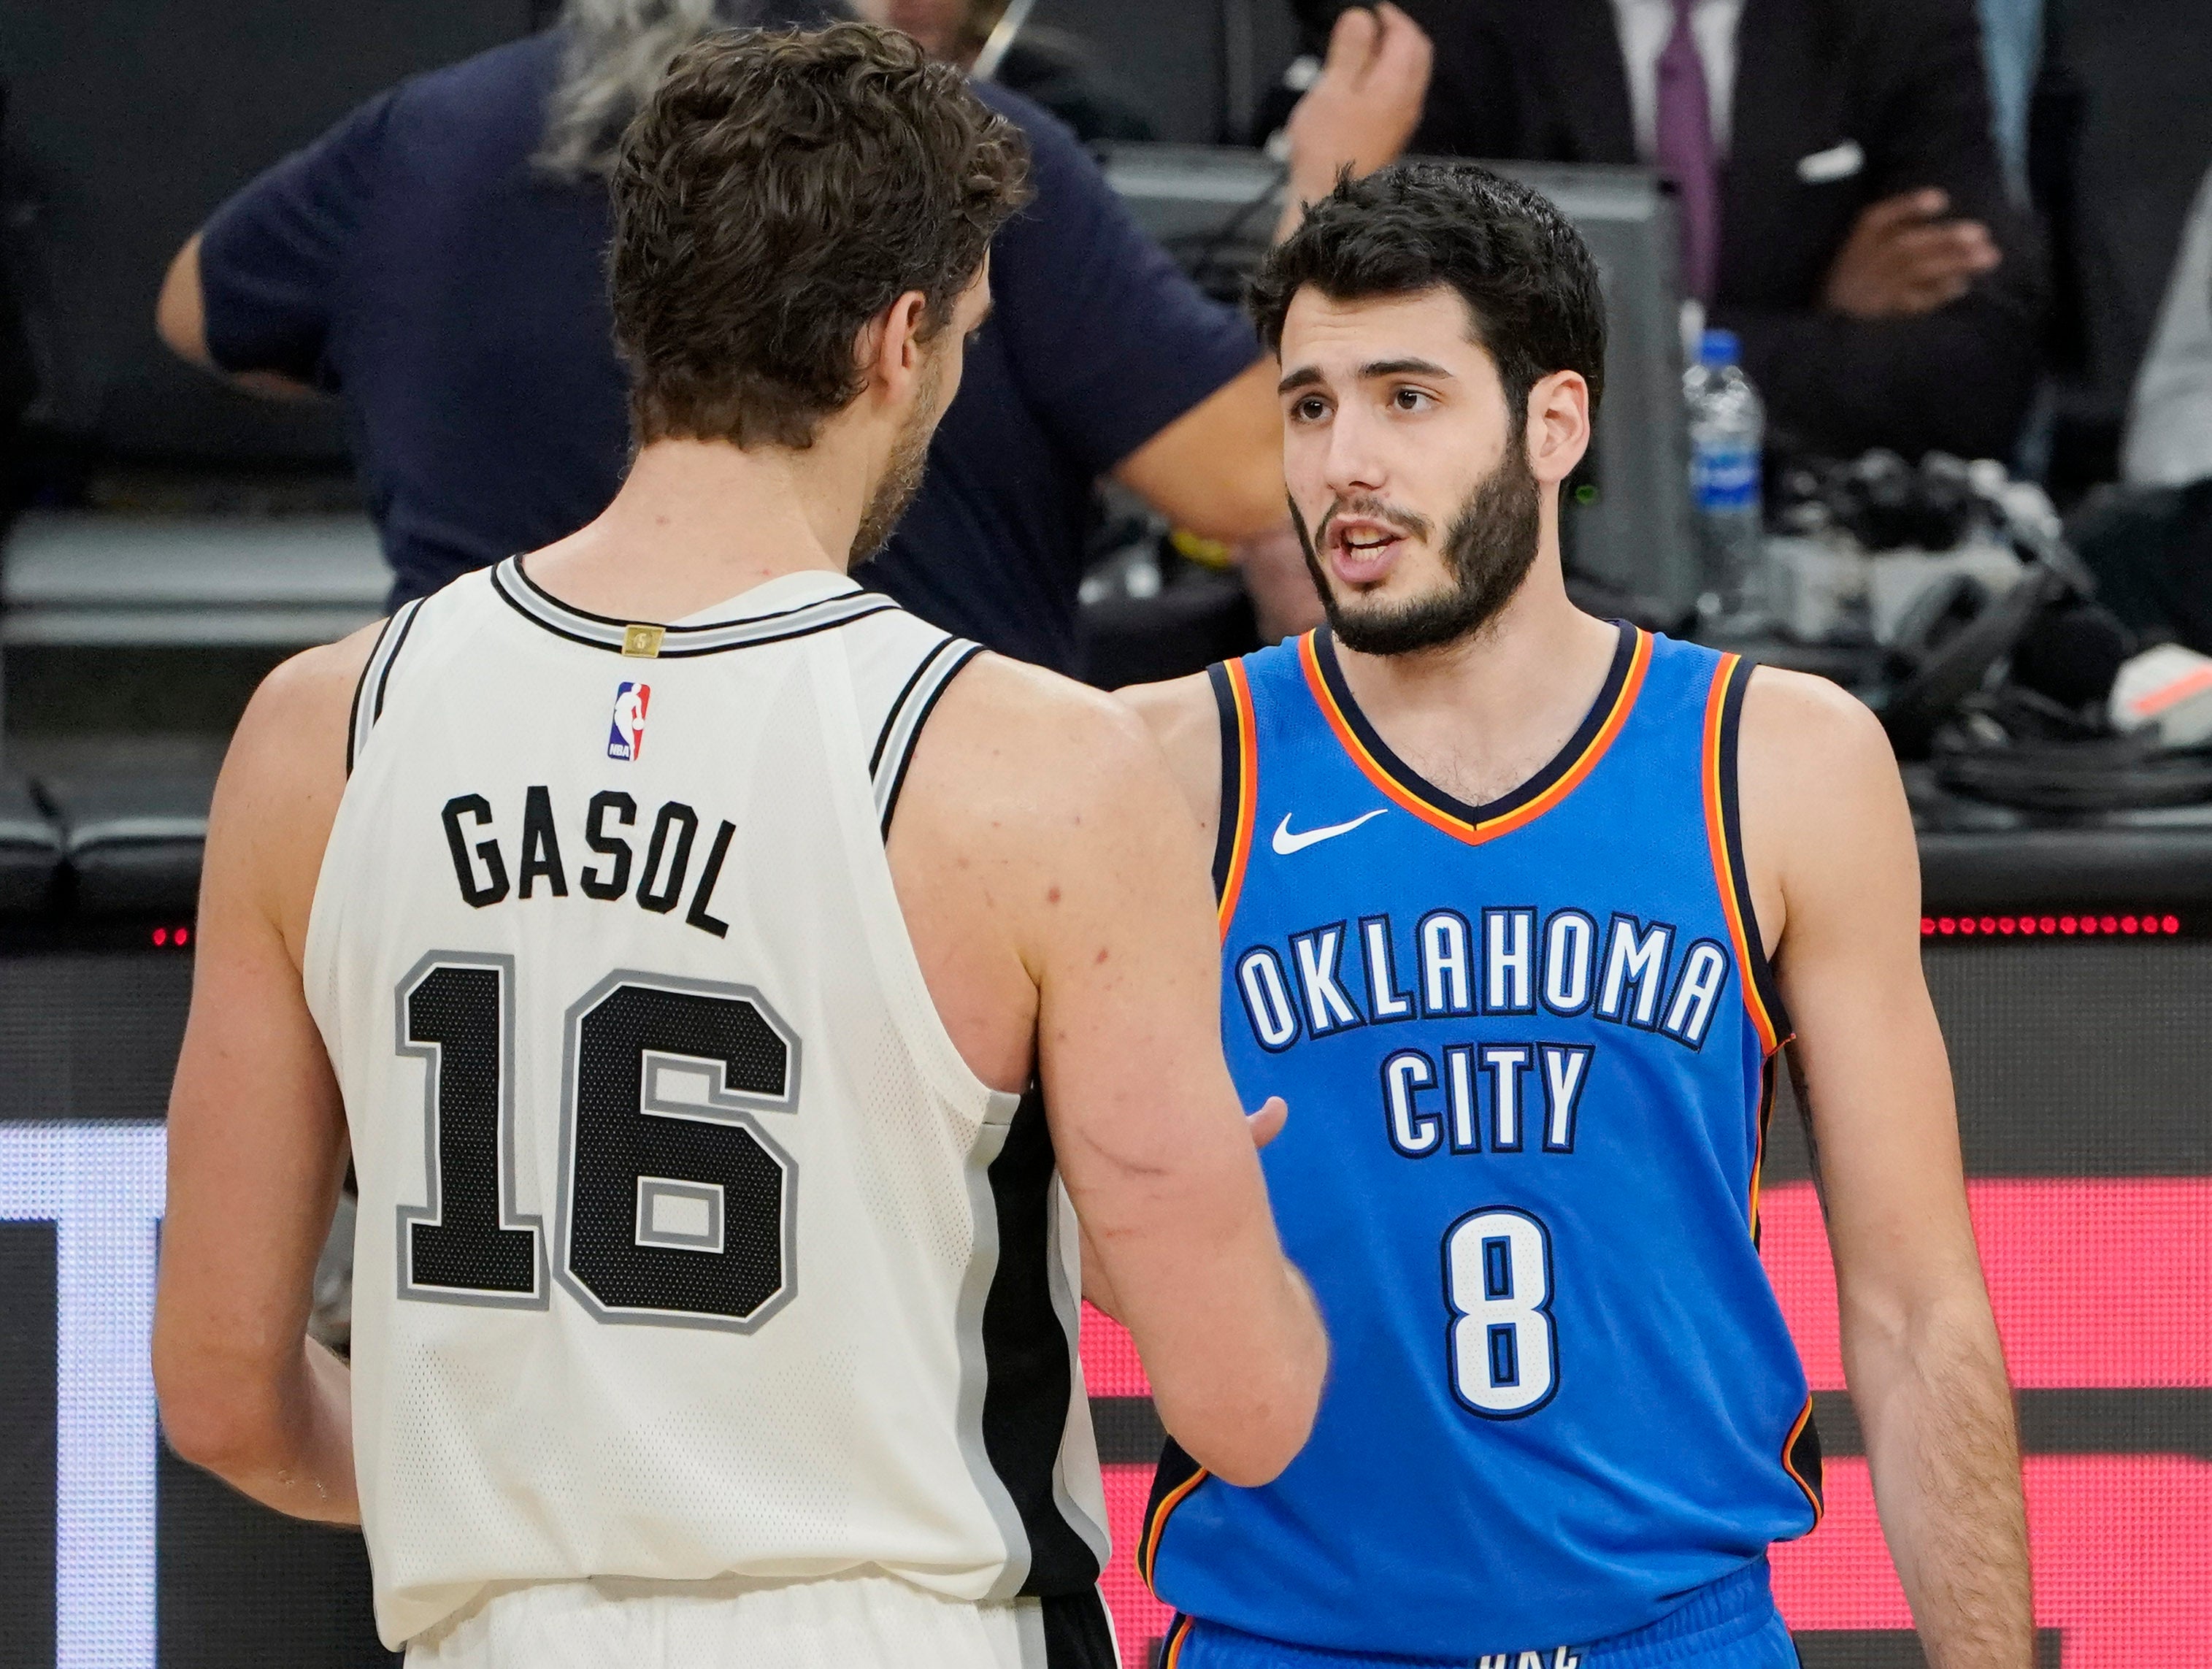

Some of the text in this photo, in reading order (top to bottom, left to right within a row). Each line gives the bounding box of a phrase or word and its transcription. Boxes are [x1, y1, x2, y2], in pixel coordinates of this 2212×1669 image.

[609, 743, 630, 758] NBA
[441, 786, 737, 940] GASOL
[1234, 905, 1731, 1053] OKLAHOMA
[394, 949, 803, 1337] 16
[1380, 1041, 1597, 1160] CITY
[1440, 1204, 1561, 1422] 8
